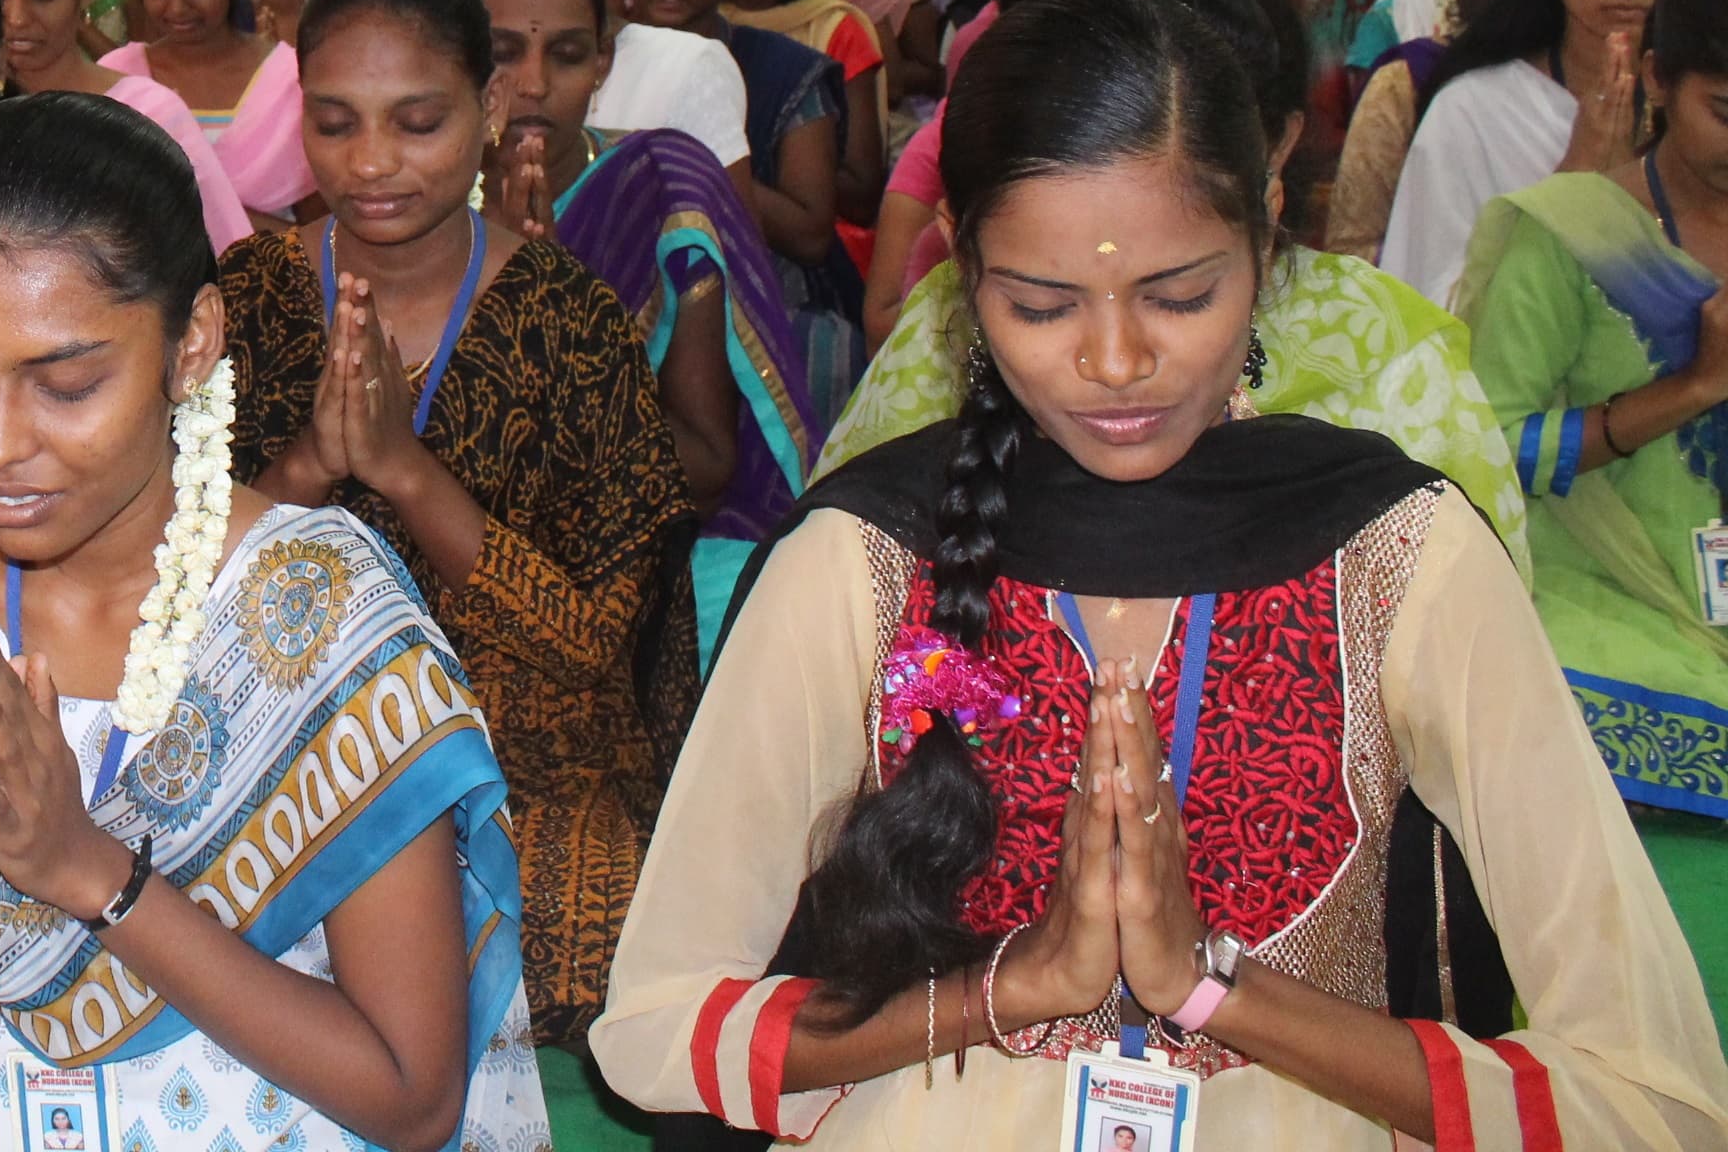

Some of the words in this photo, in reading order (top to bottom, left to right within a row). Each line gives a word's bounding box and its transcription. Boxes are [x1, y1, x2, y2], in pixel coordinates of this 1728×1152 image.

[1108, 1089, 1144, 1103] NURSING
[1128, 1082, 1162, 1097] COLLEGE
[1165, 1090, 1176, 1099] OF
